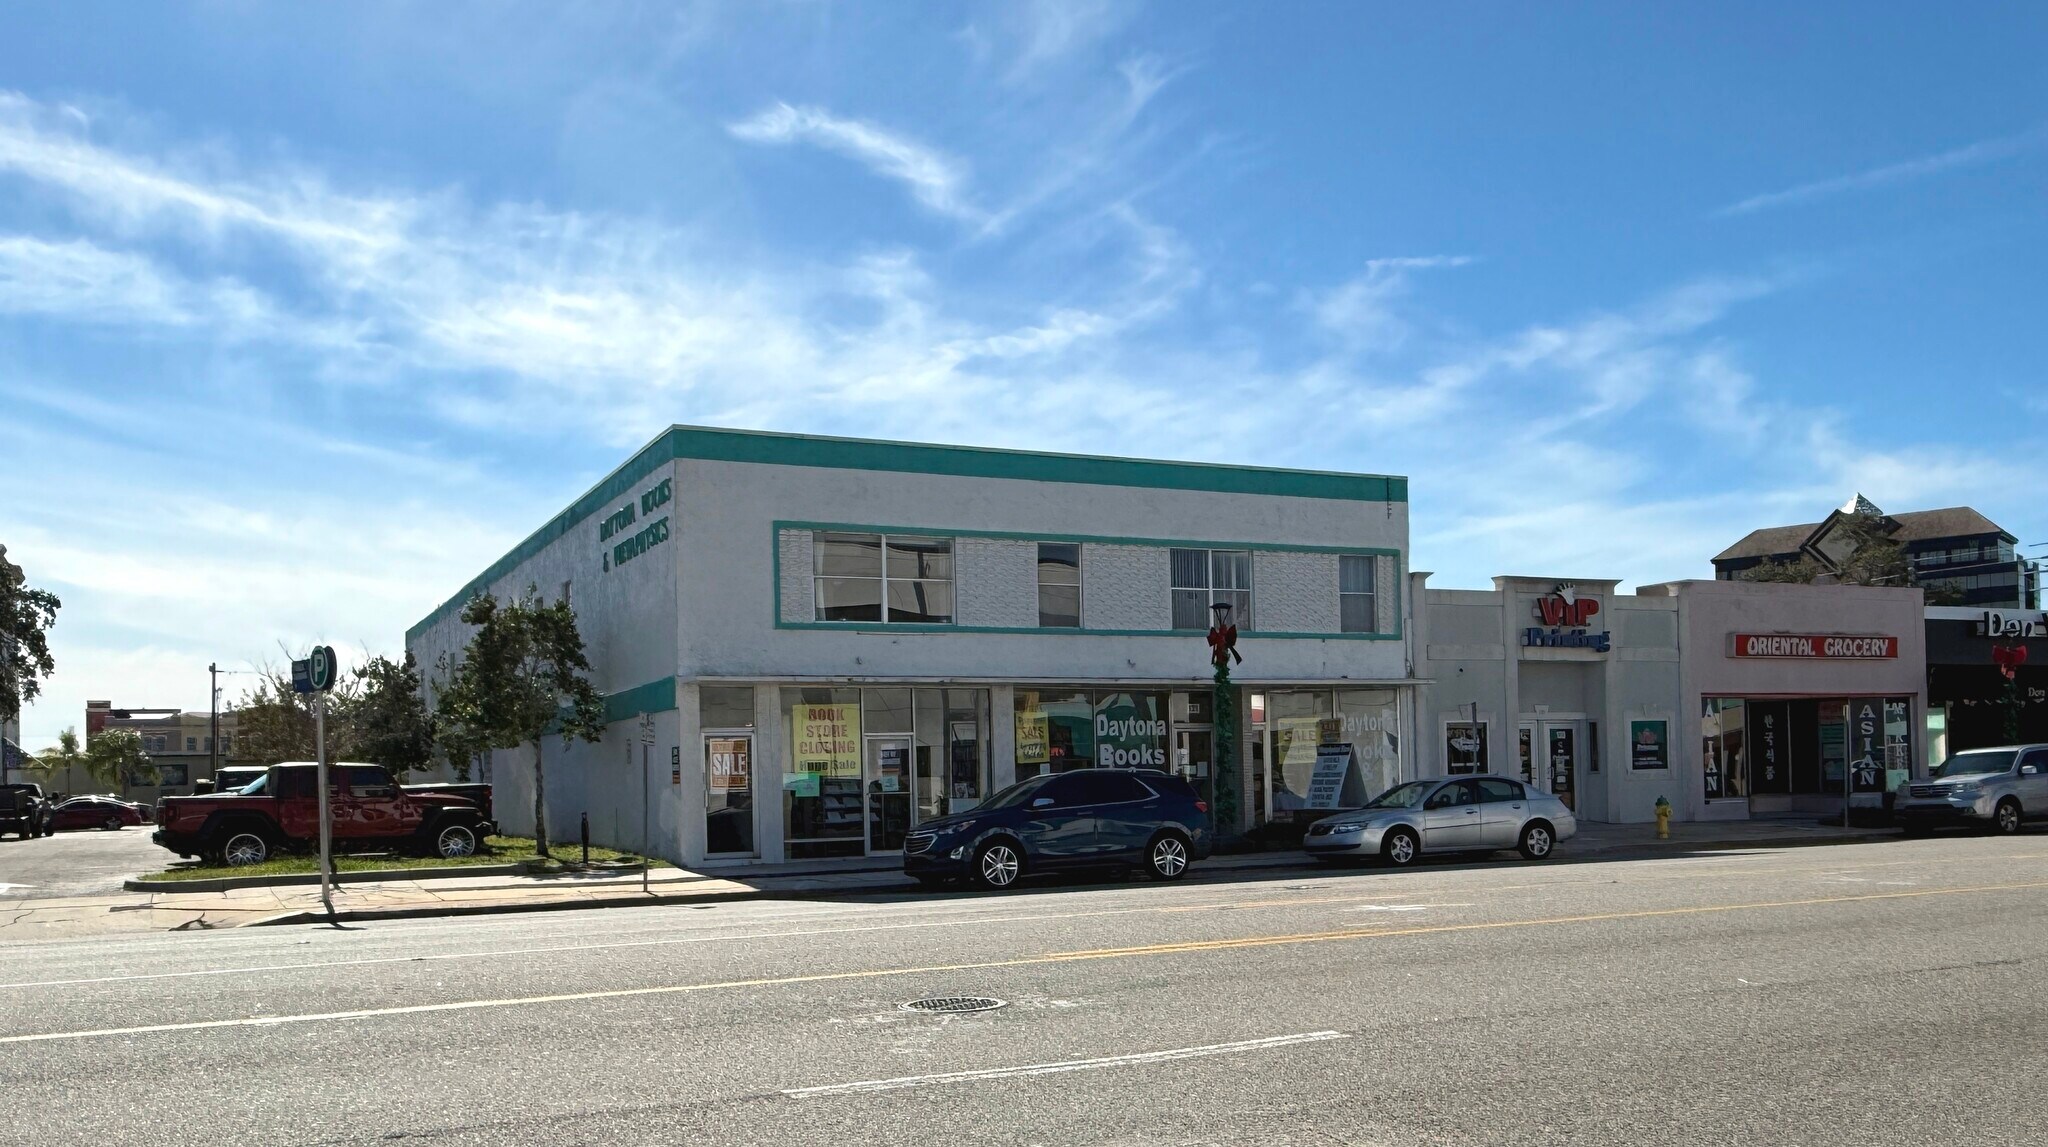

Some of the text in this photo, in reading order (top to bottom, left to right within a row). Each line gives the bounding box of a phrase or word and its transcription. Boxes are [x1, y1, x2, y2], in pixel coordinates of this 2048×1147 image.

[1537, 597, 1599, 627] VIP
[1747, 636, 1889, 657] ORIENTAL GROCERY
[314, 653, 324, 682] P
[808, 708, 845, 721] BOOK
[806, 724, 848, 738] STORE
[1096, 713, 1167, 741] Daytona
[800, 740, 856, 755] CLOSING
[1099, 743, 1165, 766] Books
[1860, 704, 1877, 785] ASIAN
[713, 753, 746, 775] SALE
